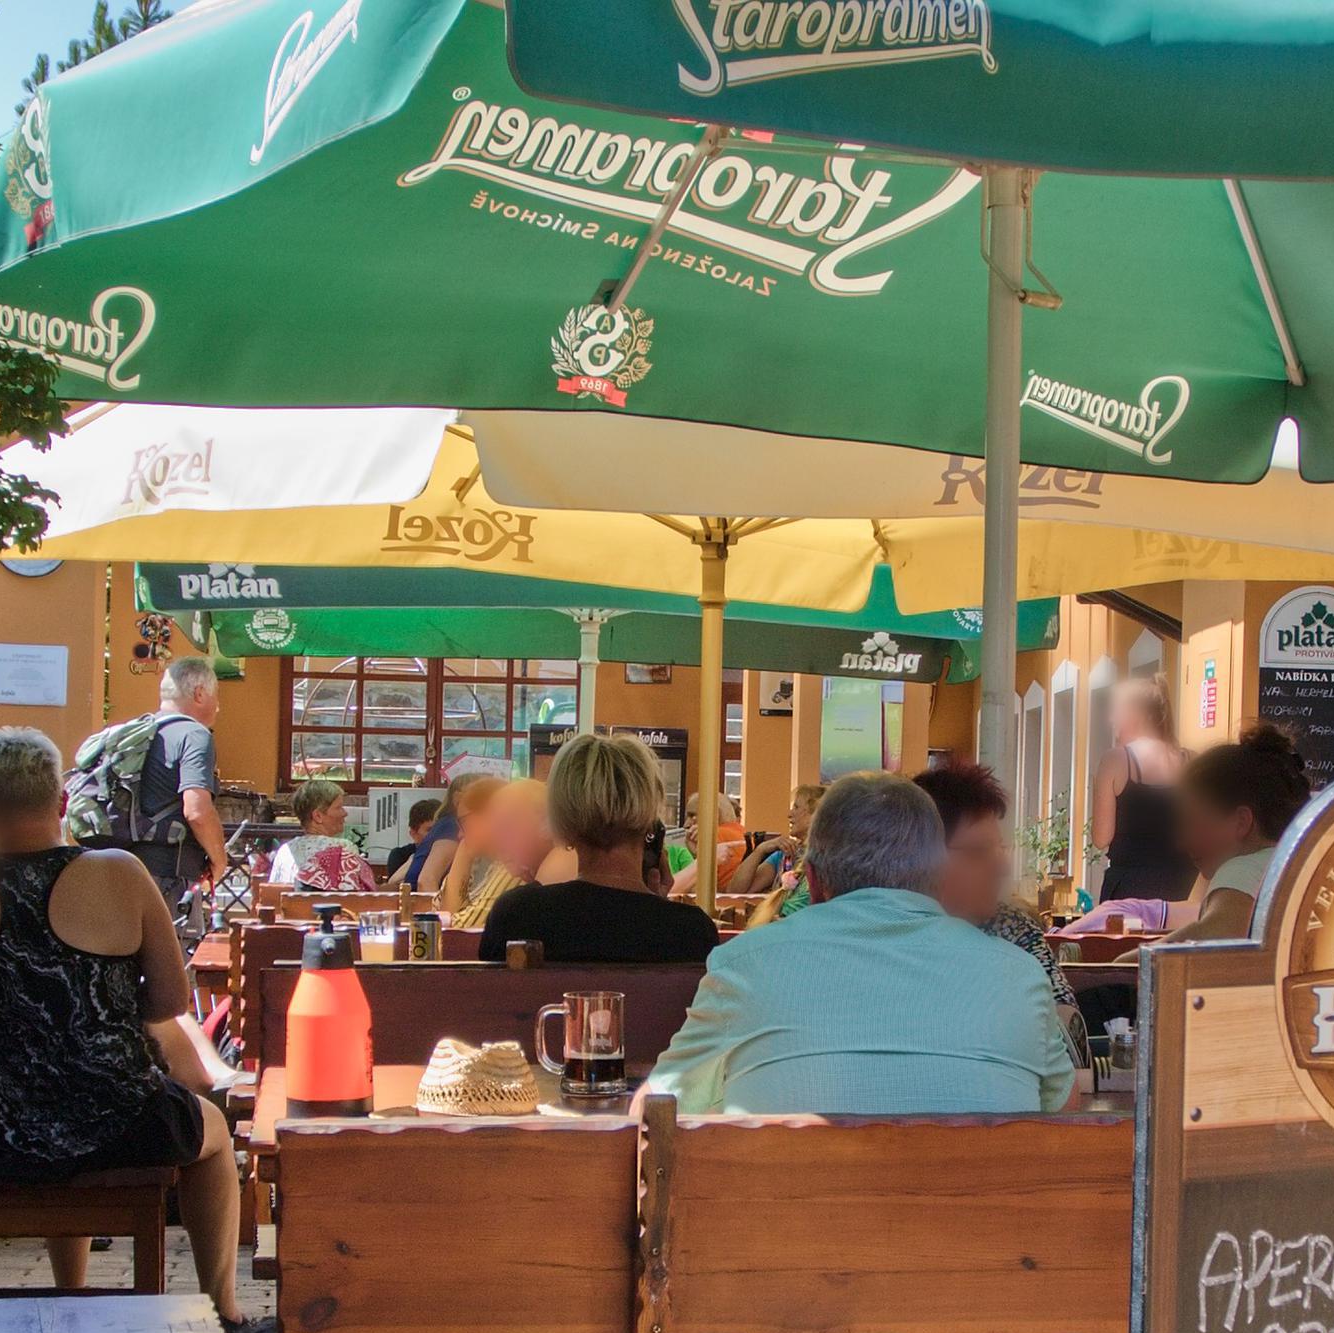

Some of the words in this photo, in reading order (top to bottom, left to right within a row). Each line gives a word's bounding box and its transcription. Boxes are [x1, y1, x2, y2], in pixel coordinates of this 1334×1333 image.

[122, 438, 214, 506] Kozel
[932, 455, 1104, 508] Kzel
[1275, 670, 1329, 682] NABÍDKA
[549, 726, 579, 746] kofol
